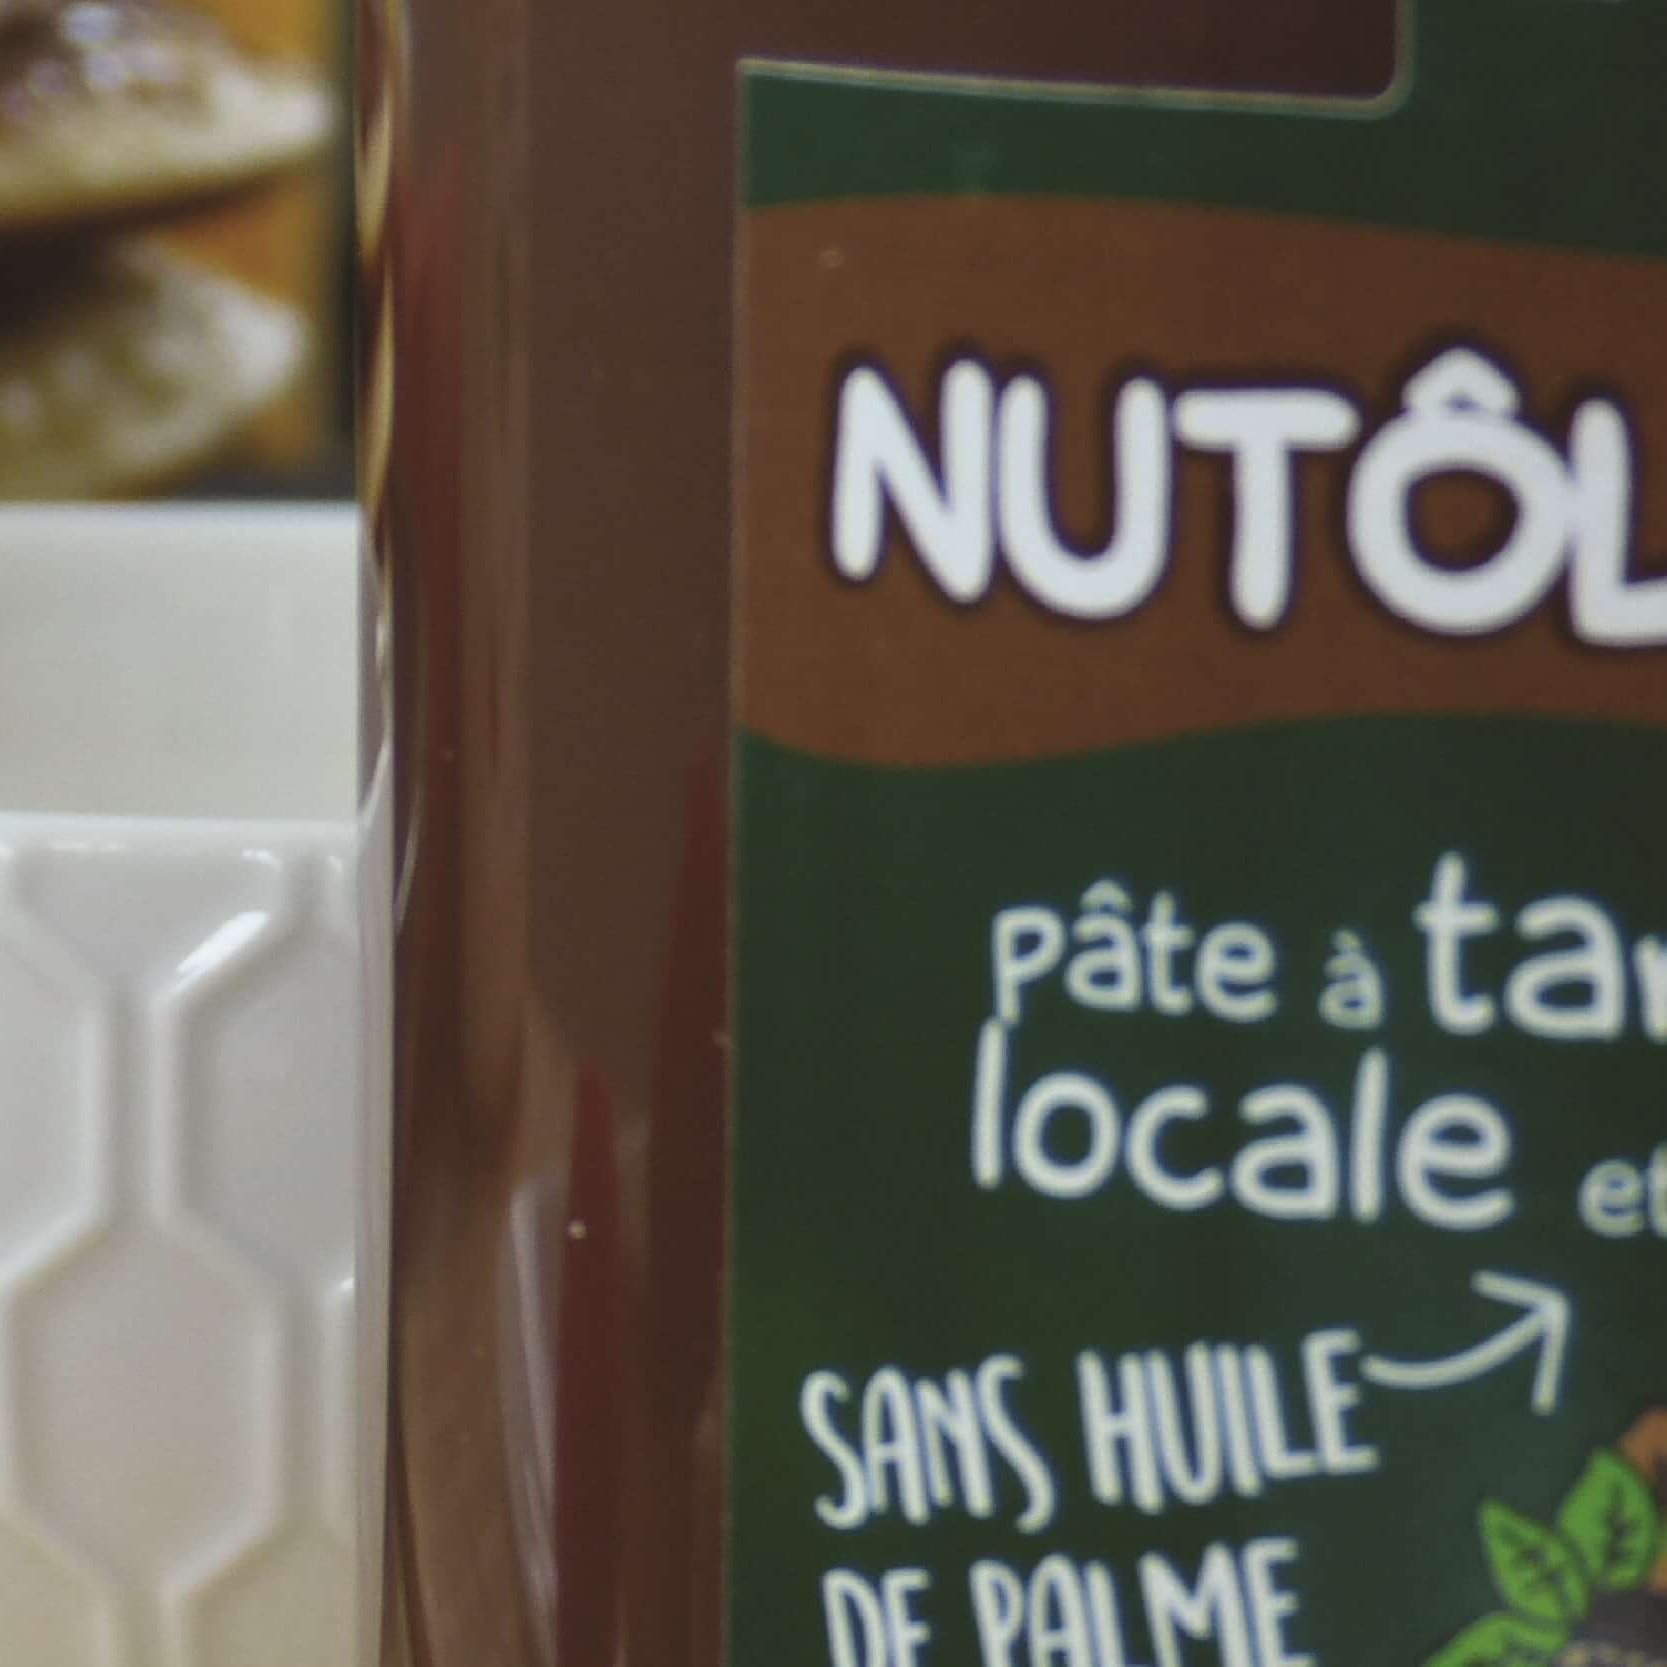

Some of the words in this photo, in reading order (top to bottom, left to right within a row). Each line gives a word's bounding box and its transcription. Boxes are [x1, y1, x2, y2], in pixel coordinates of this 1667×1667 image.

[993, 880, 1275, 1025] pâte
[1319, 929, 1384, 1029] à
[972, 1015, 1516, 1231] locale
[800, 1354, 1056, 1532] SANS
[1077, 1329, 1379, 1514] HUILE
